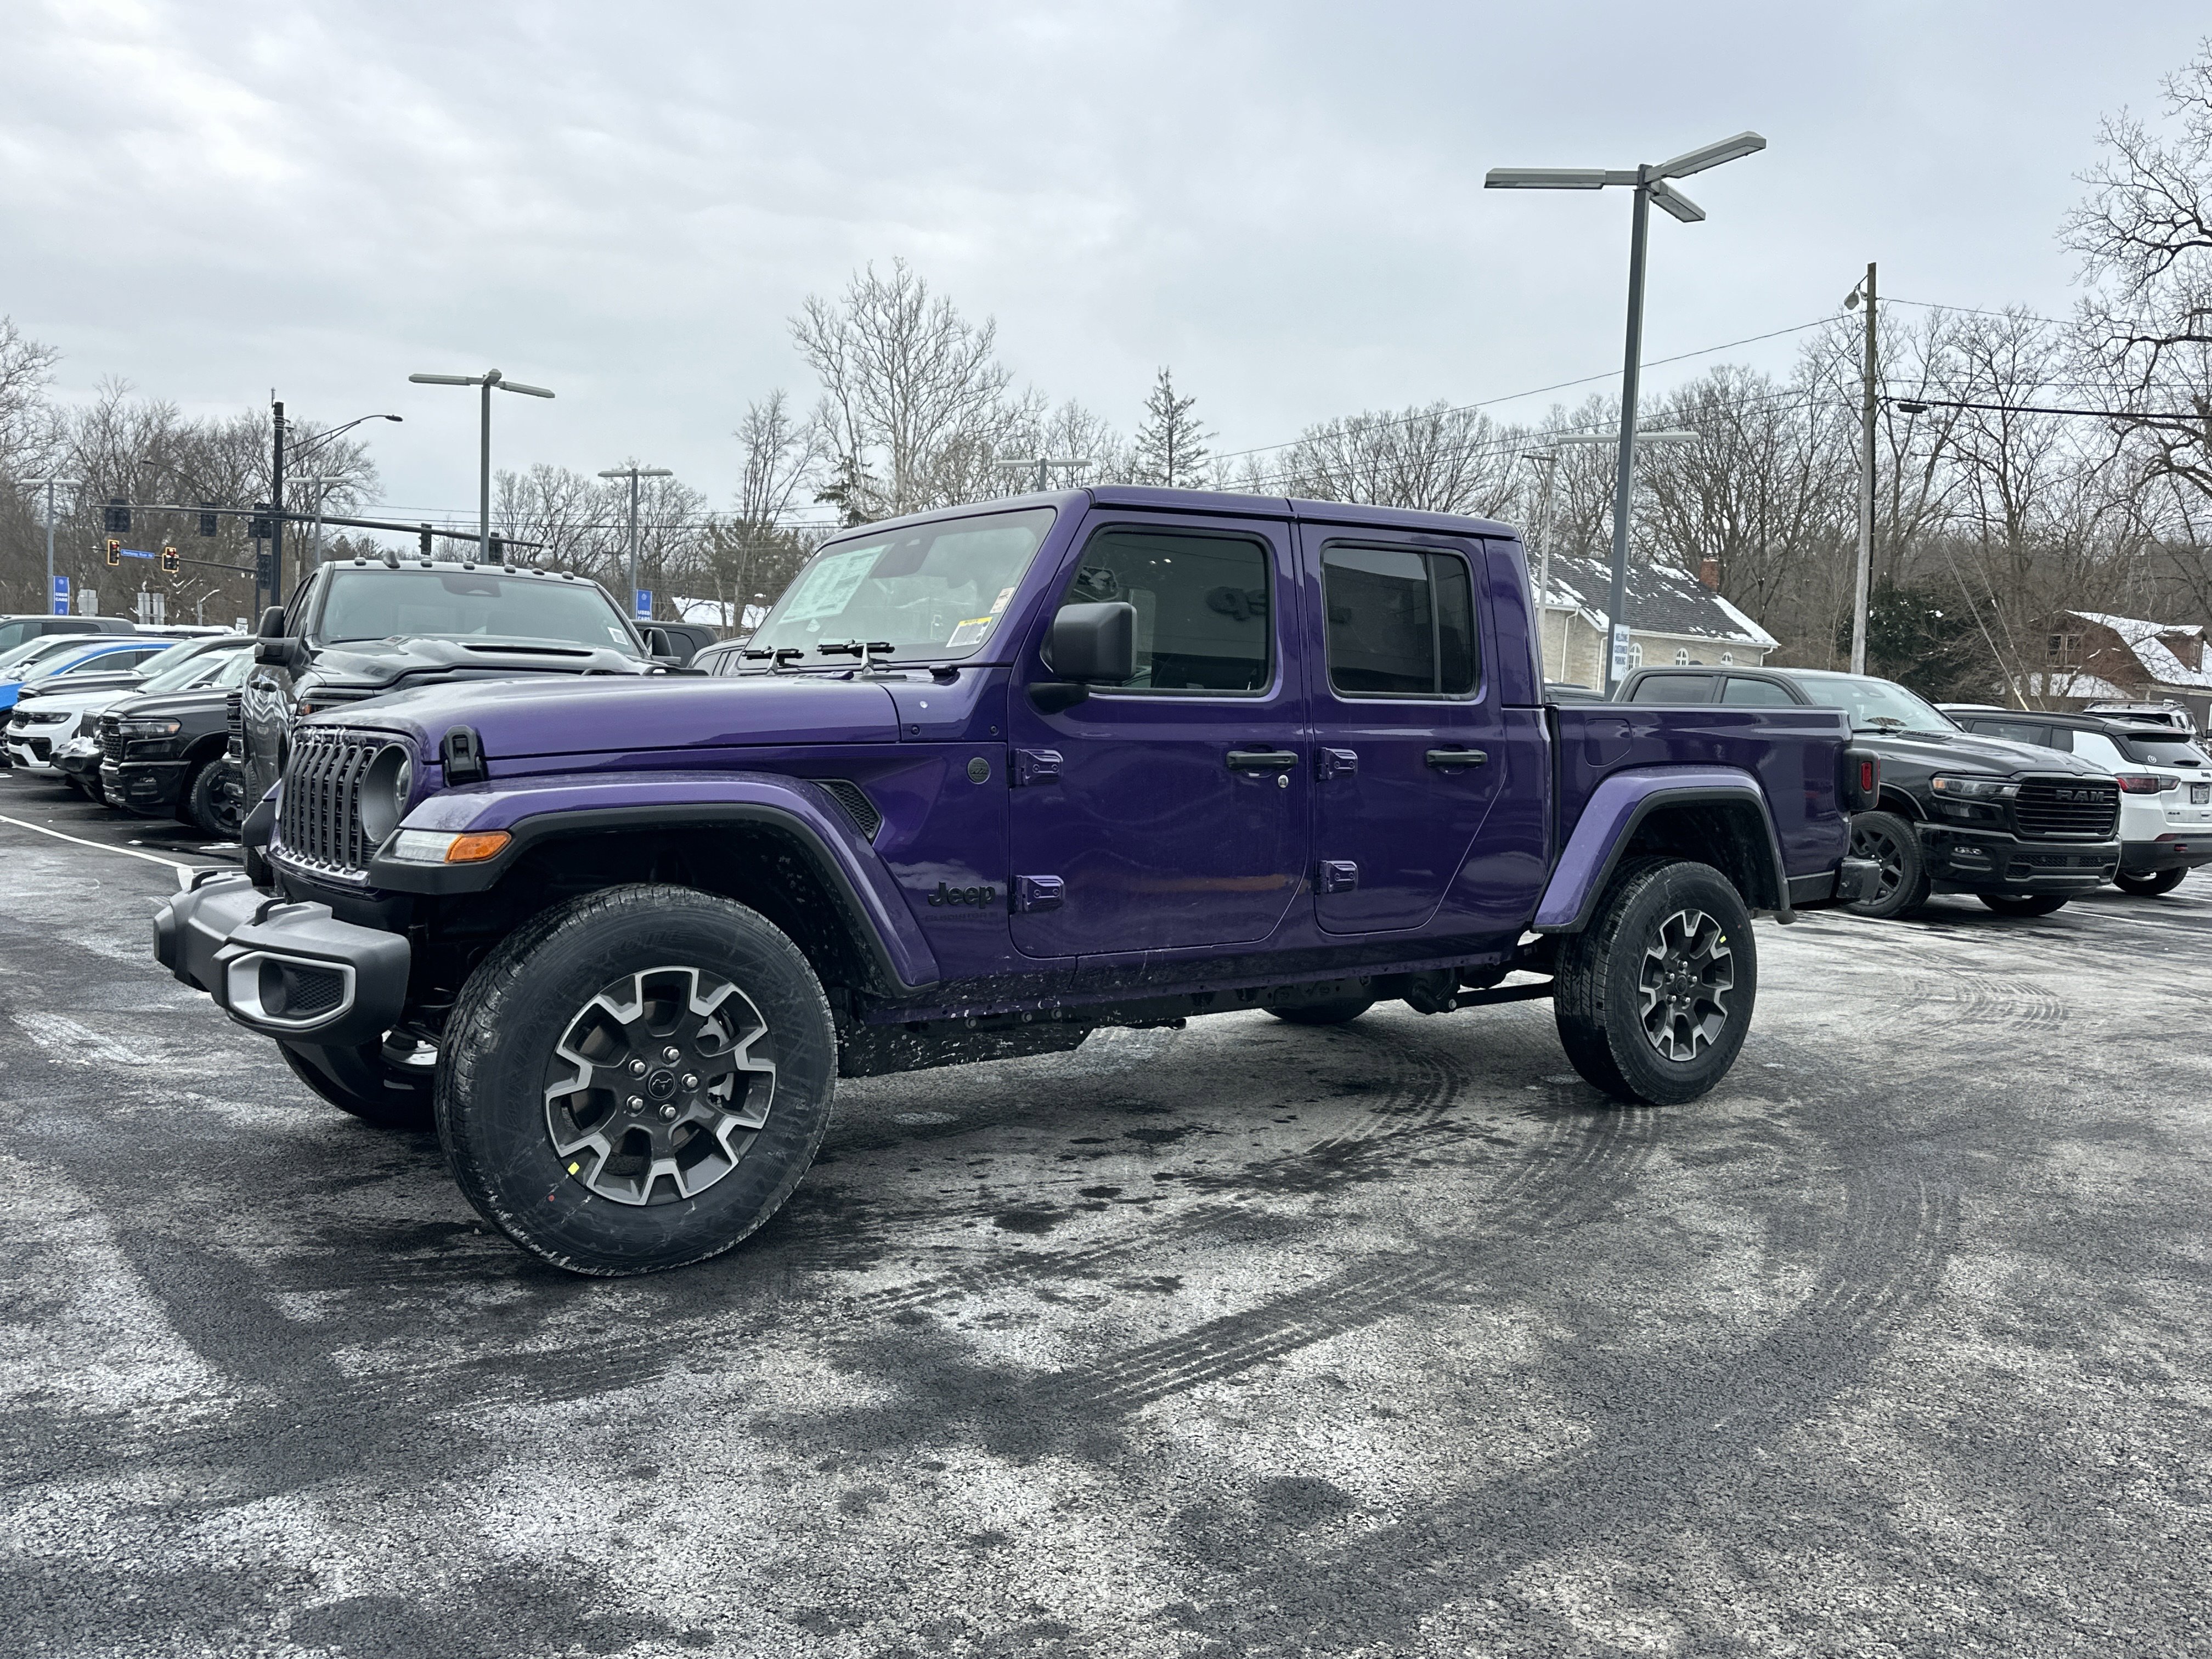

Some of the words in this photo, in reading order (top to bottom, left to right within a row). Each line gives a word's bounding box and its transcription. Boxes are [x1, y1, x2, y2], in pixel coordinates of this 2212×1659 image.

[2055, 789, 2104, 802] RAM
[928, 881, 996, 909] Jeep
[925, 911, 988, 922] GLADIATOR
